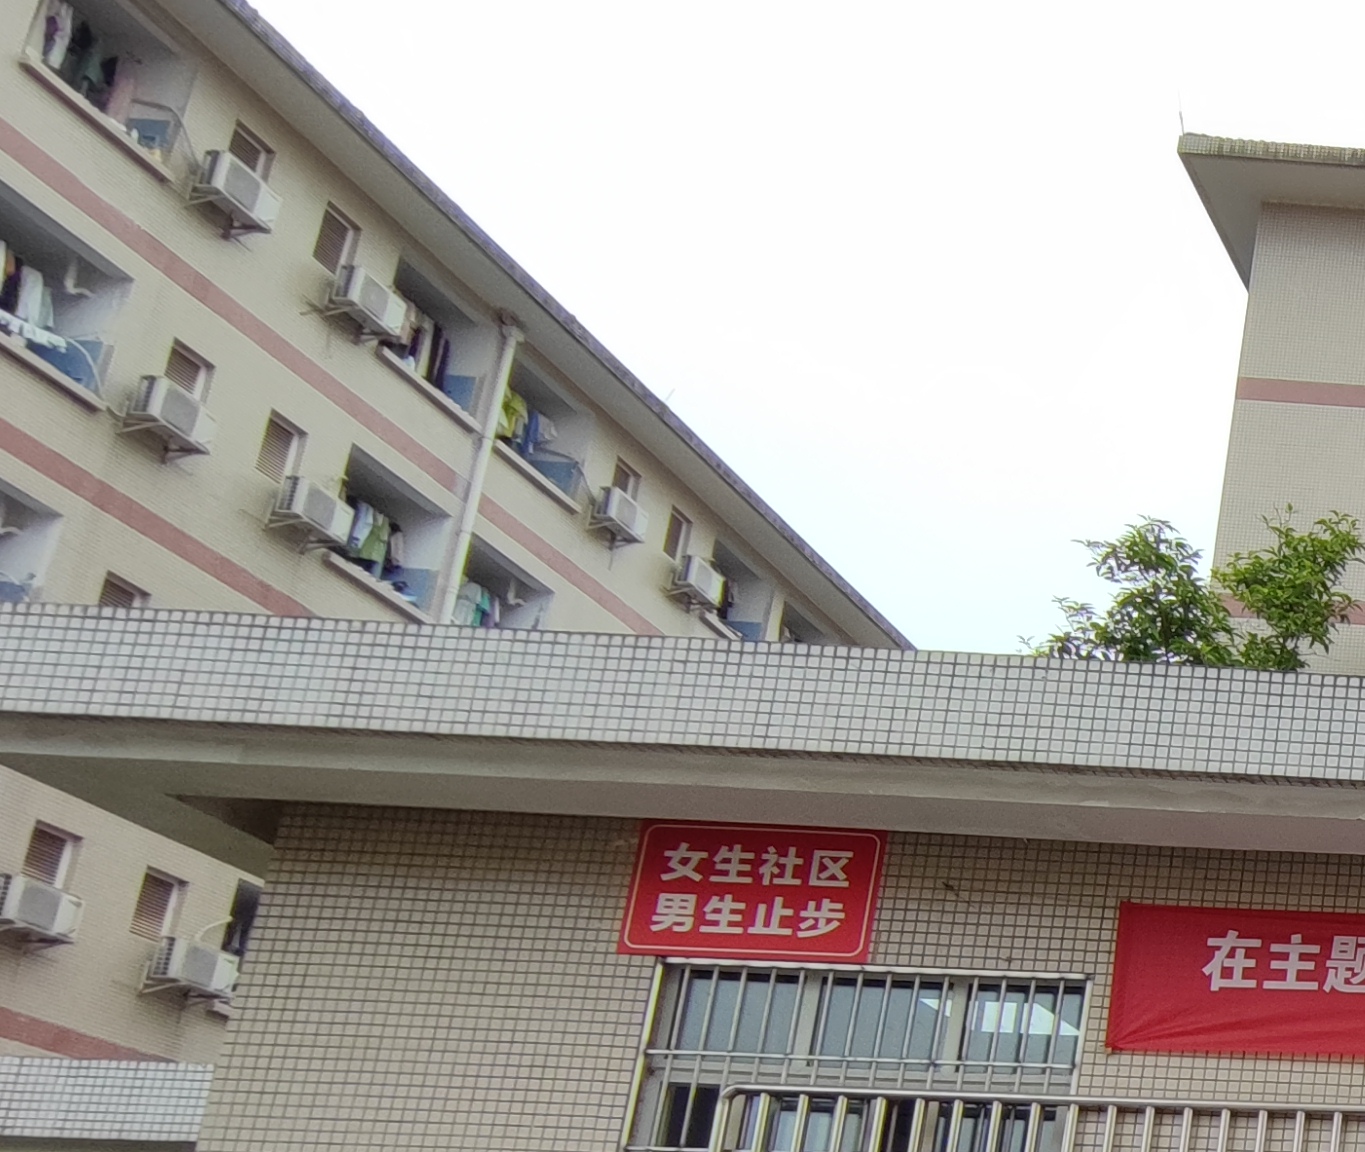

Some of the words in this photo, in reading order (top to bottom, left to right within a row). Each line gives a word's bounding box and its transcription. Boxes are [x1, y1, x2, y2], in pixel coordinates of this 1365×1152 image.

[660, 842, 854, 888] 女生社区
[650, 893, 846, 938] 男生止步
